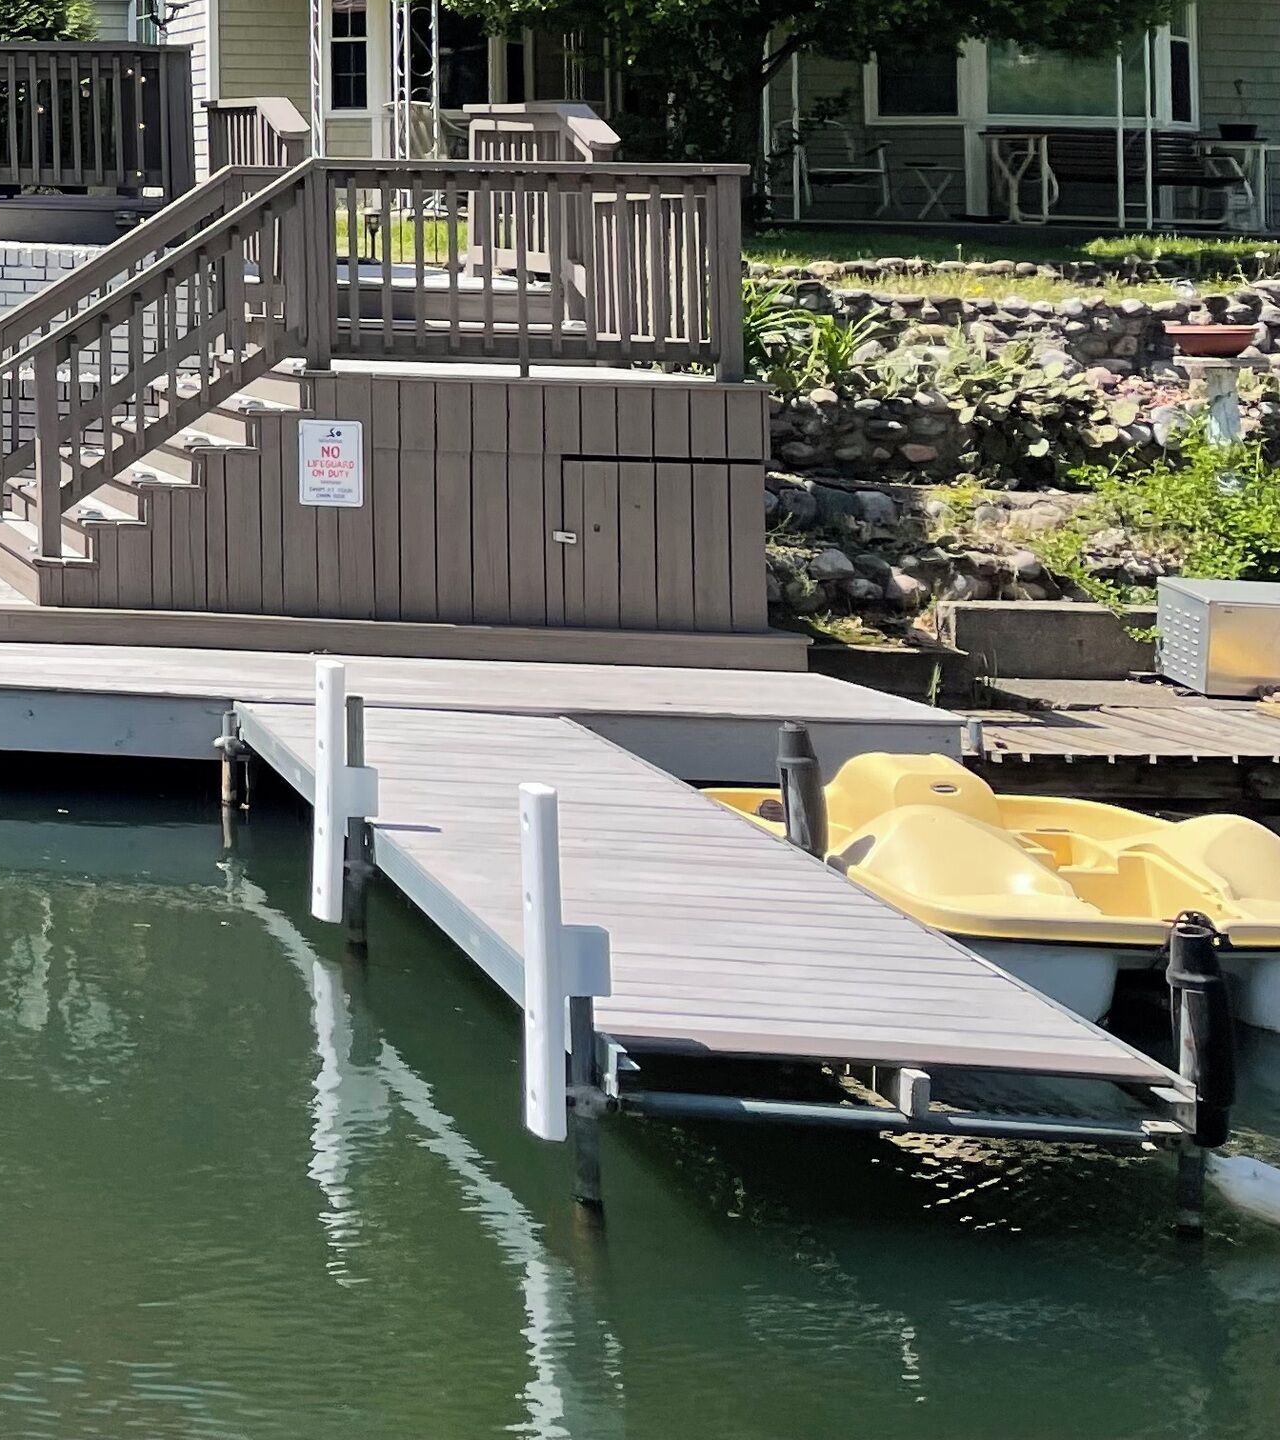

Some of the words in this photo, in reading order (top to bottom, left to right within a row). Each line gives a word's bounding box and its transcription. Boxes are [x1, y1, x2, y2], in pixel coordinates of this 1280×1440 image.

[321, 446, 341, 459] NO
[307, 460, 355, 469] LIFEGUARD
[328, 470, 350, 479] DUTY
